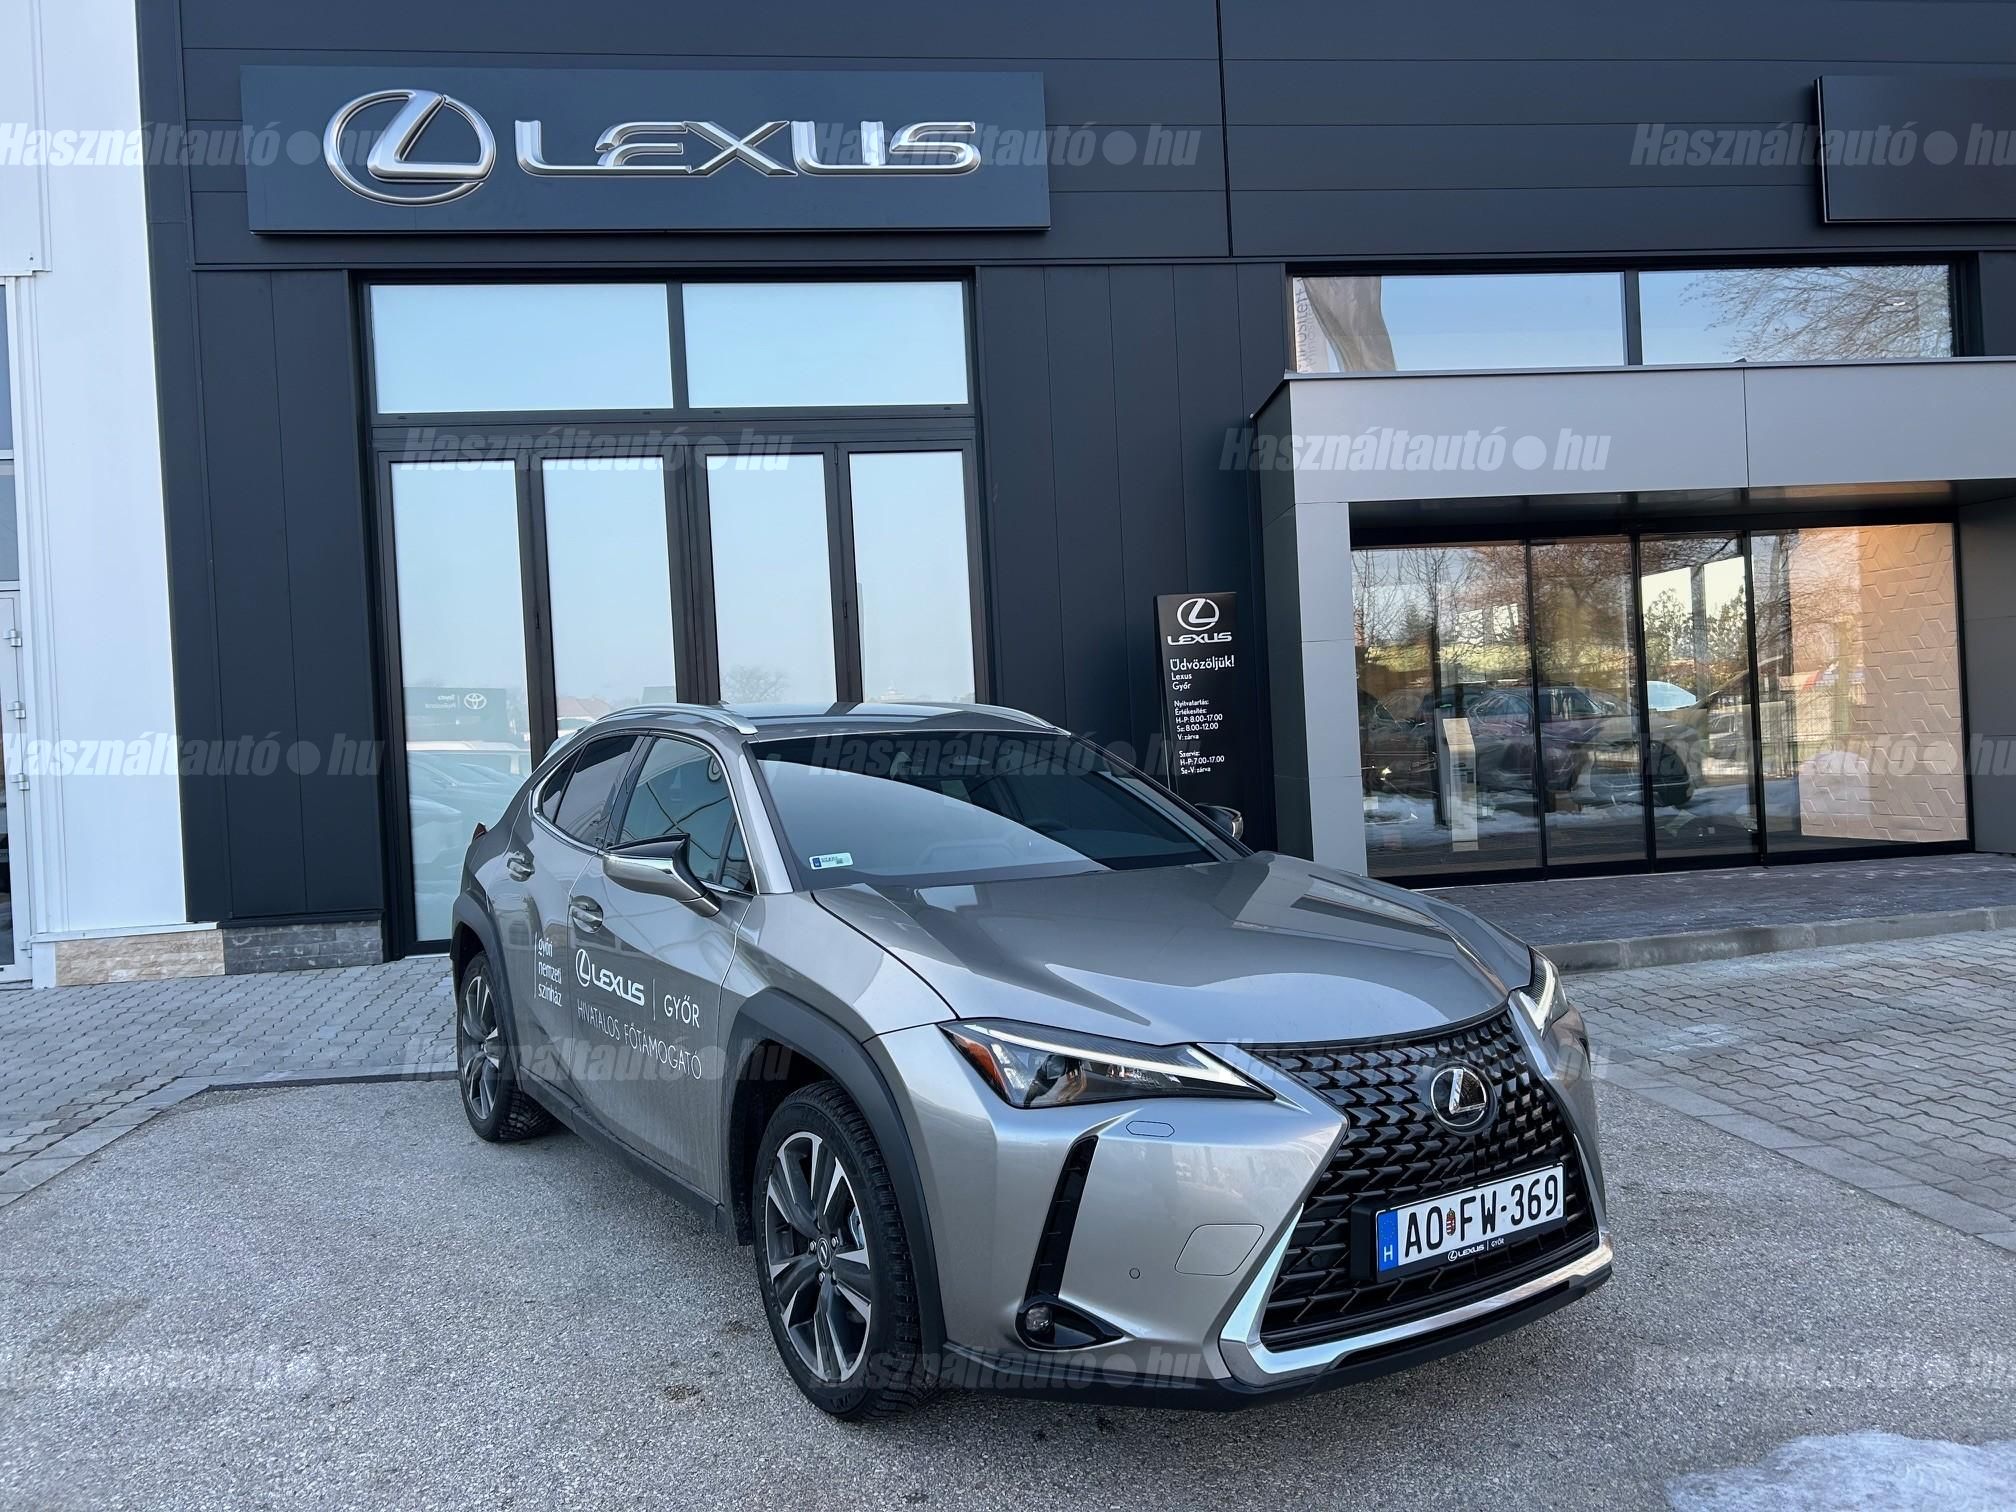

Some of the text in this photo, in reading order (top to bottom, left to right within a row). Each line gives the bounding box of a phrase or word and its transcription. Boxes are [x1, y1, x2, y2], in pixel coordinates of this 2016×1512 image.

[514, 119, 981, 178] LEXUS
[1167, 632, 1233, 645] LEXUS
[1170, 655, 1235, 671] Üdvözöljük!
[1171, 672, 1192, 680] Lexus
[1172, 682, 1191, 691] Győr
[592, 964, 645, 1006] LEXUS
[664, 994, 700, 1028] GYŐR
[577, 1000, 702, 1080] HIVATALOS FŐTÁMOGATÓ
[1384, 1245, 1393, 1262] H
[1458, 1244, 1485, 1257] LEXUS
